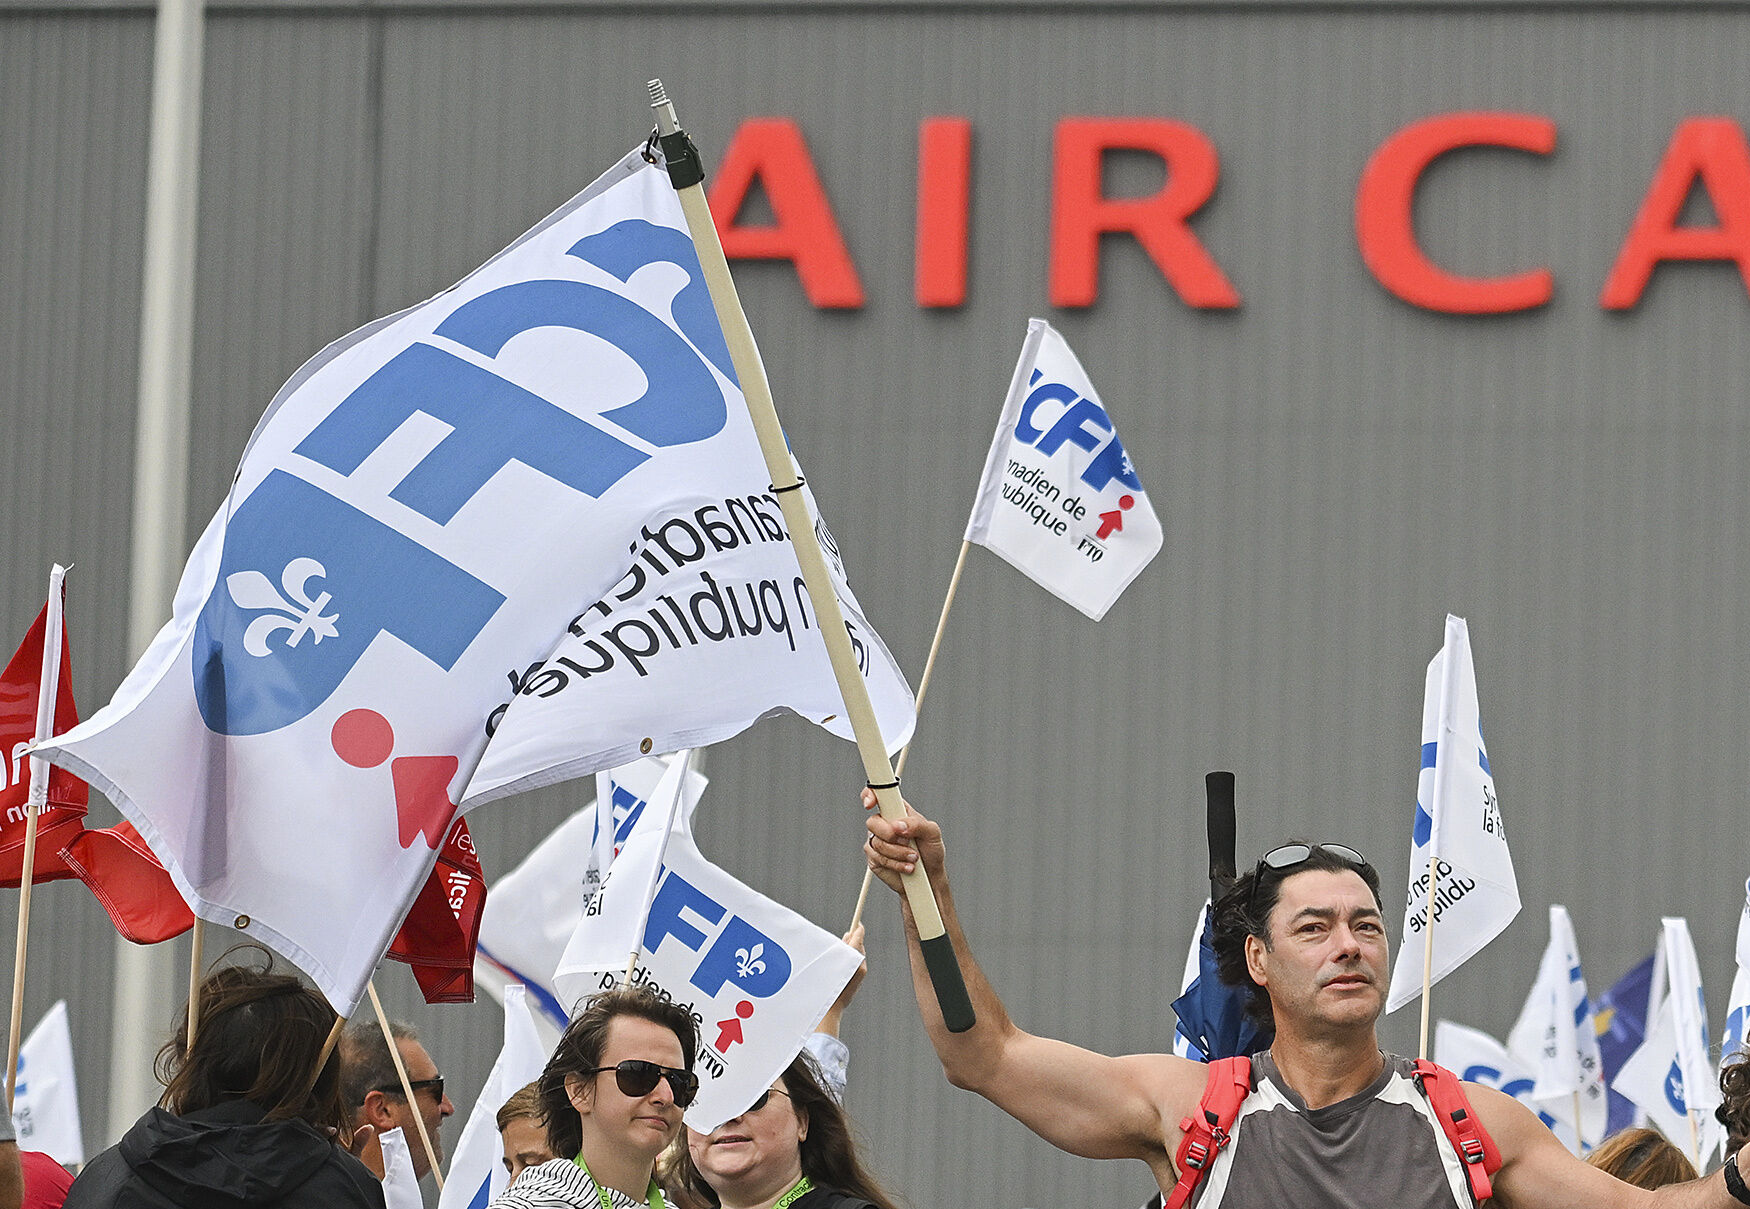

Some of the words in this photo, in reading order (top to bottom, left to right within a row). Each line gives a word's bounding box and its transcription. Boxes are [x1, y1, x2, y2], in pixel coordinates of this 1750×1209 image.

[705, 116, 1242, 308] AIR
[1014, 367, 1144, 493] CFP
[1002, 482, 1068, 537] ublique
[1007, 458, 1061, 503] nadien
[1062, 495, 1086, 521] de
[1077, 538, 1105, 563] FTQ
[643, 862, 792, 999] FP
